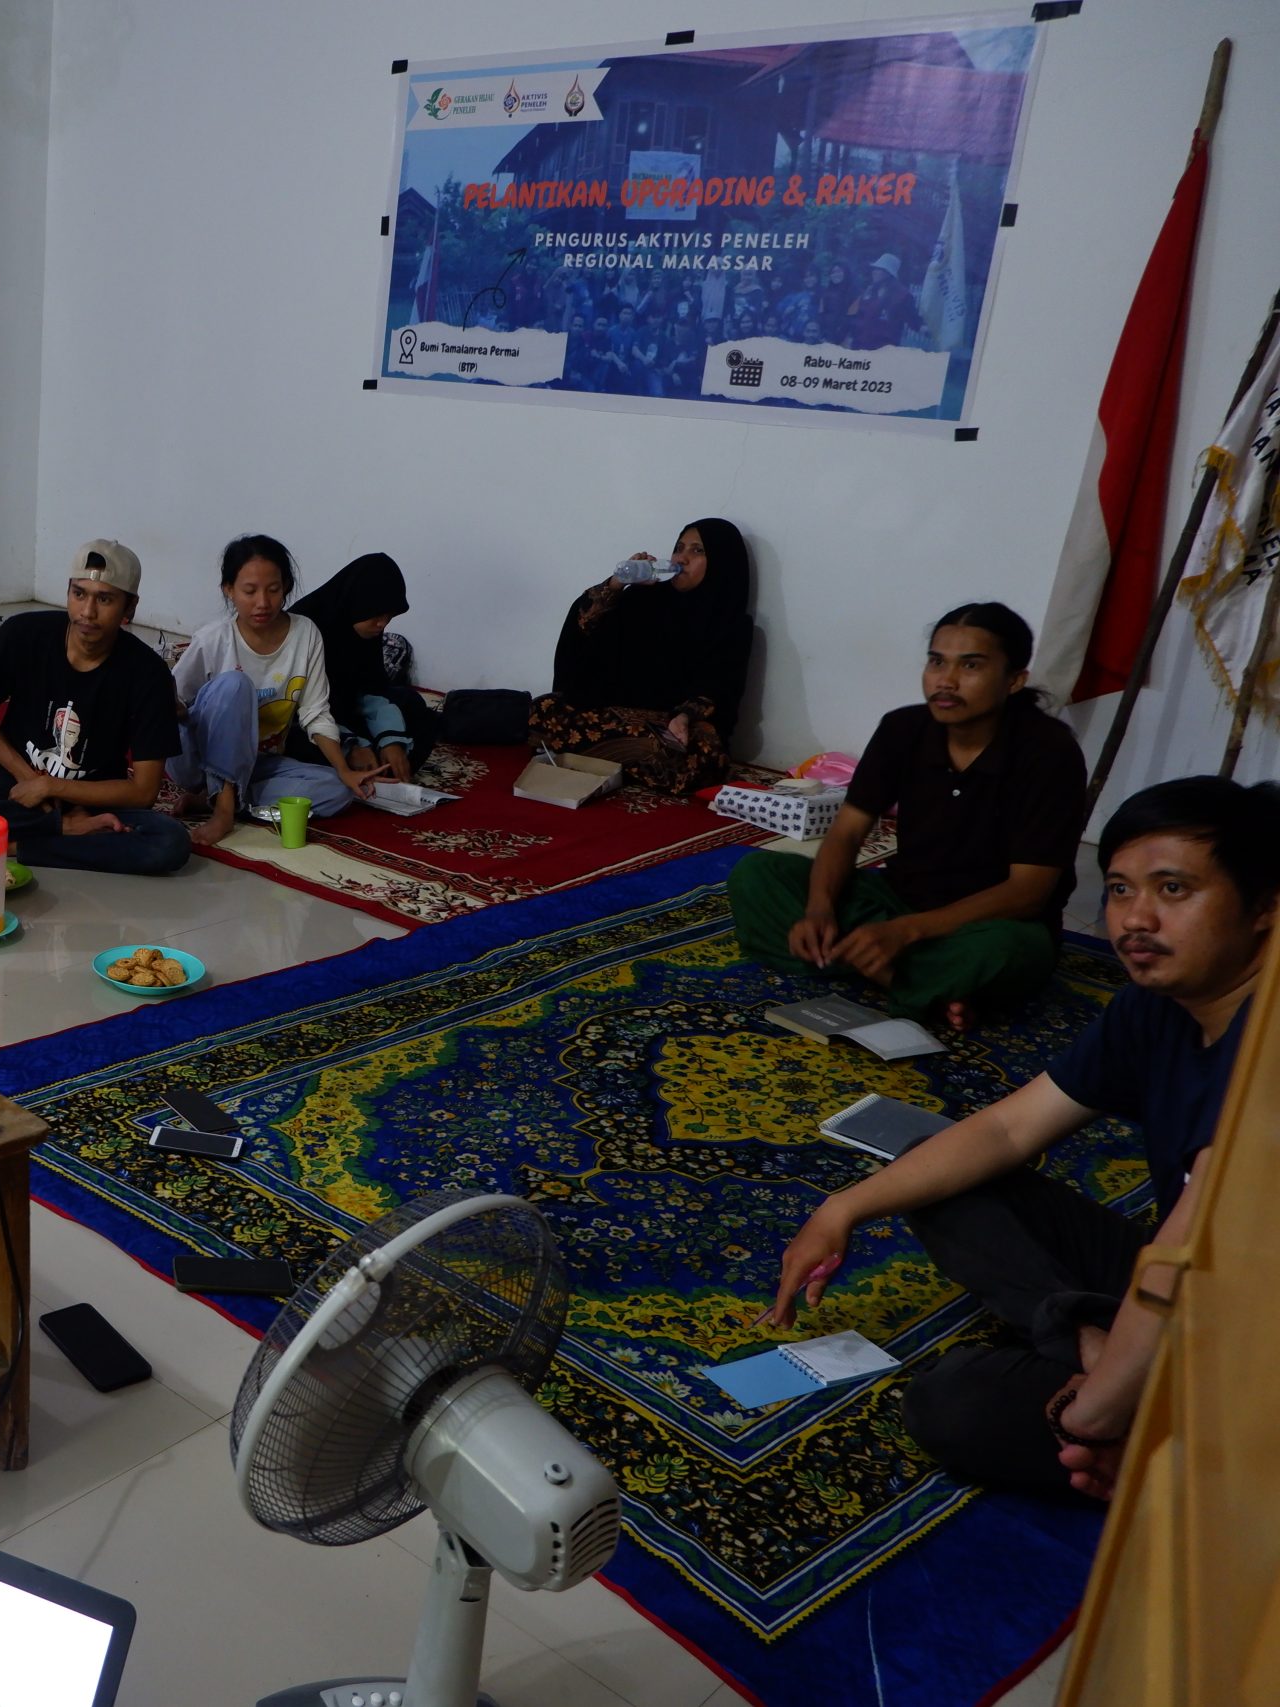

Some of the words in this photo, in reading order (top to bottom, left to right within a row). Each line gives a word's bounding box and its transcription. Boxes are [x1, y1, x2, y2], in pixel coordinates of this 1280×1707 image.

[520, 100, 547, 108] PENELEH
[521, 93, 548, 101] AKTIVIS
[463, 179, 612, 209] PELANTIKAN,
[620, 175, 775, 208] UPGRADING
[782, 174, 807, 207] &
[816, 172, 917, 207] RAKER
[534, 232, 628, 248] PENGURUS
[634, 232, 713, 249] AKTIVIS
[720, 232, 810, 249] PENELEH
[563, 253, 654, 269] REGIONAL
[662, 254, 773, 271] MAKASSAR
[420, 341, 439, 353] Bumi
[441, 342, 488, 356] Tamalanrea
[489, 346, 520, 358] Permai
[458, 362, 478, 374] (BTP)
[803, 355, 872, 371] Rabu-Kamis
[780, 375, 819, 389] 08-09
[822, 377, 858, 392] Maret
[860, 380, 893, 394] 2023
